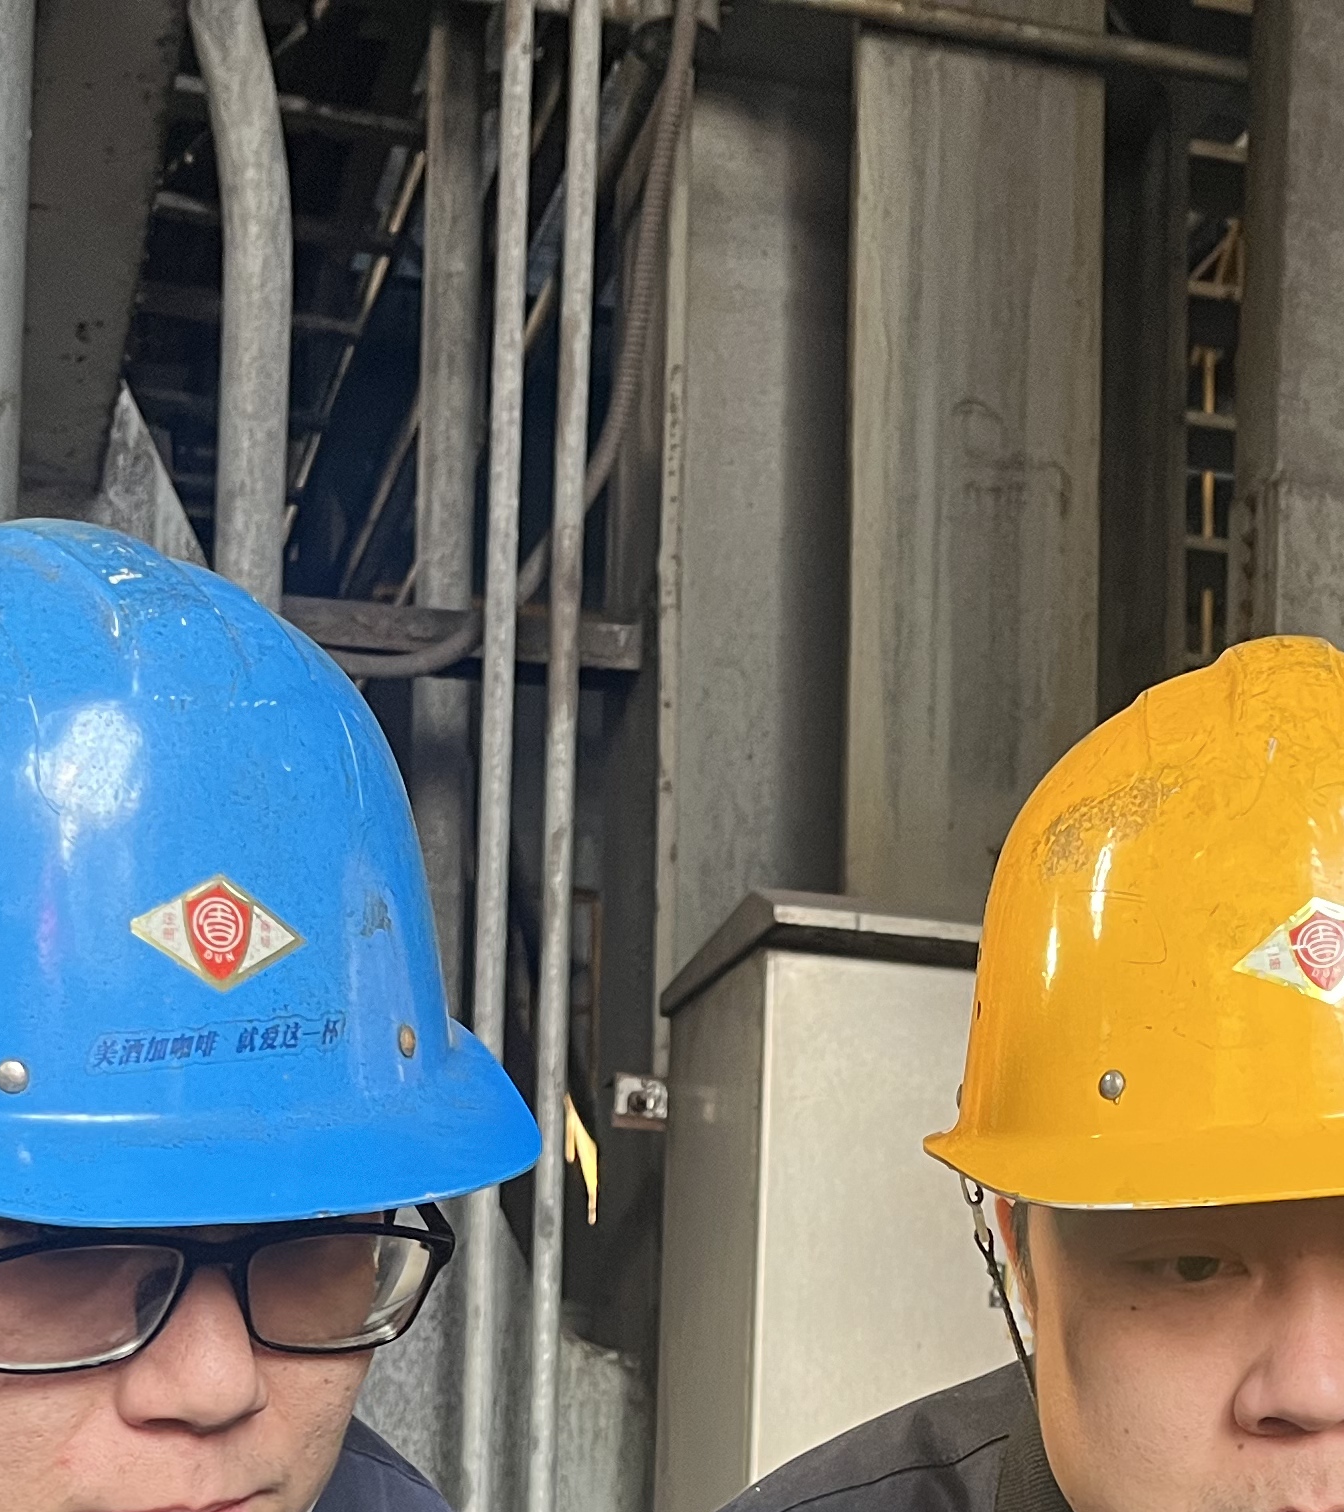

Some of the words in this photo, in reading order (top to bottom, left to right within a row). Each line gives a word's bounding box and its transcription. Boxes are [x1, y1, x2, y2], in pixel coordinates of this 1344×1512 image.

[203, 950, 236, 964] DUN
[93, 1030, 219, 1068] 美酒加咖啡
[235, 1018, 340, 1053] 就爱这一杯
